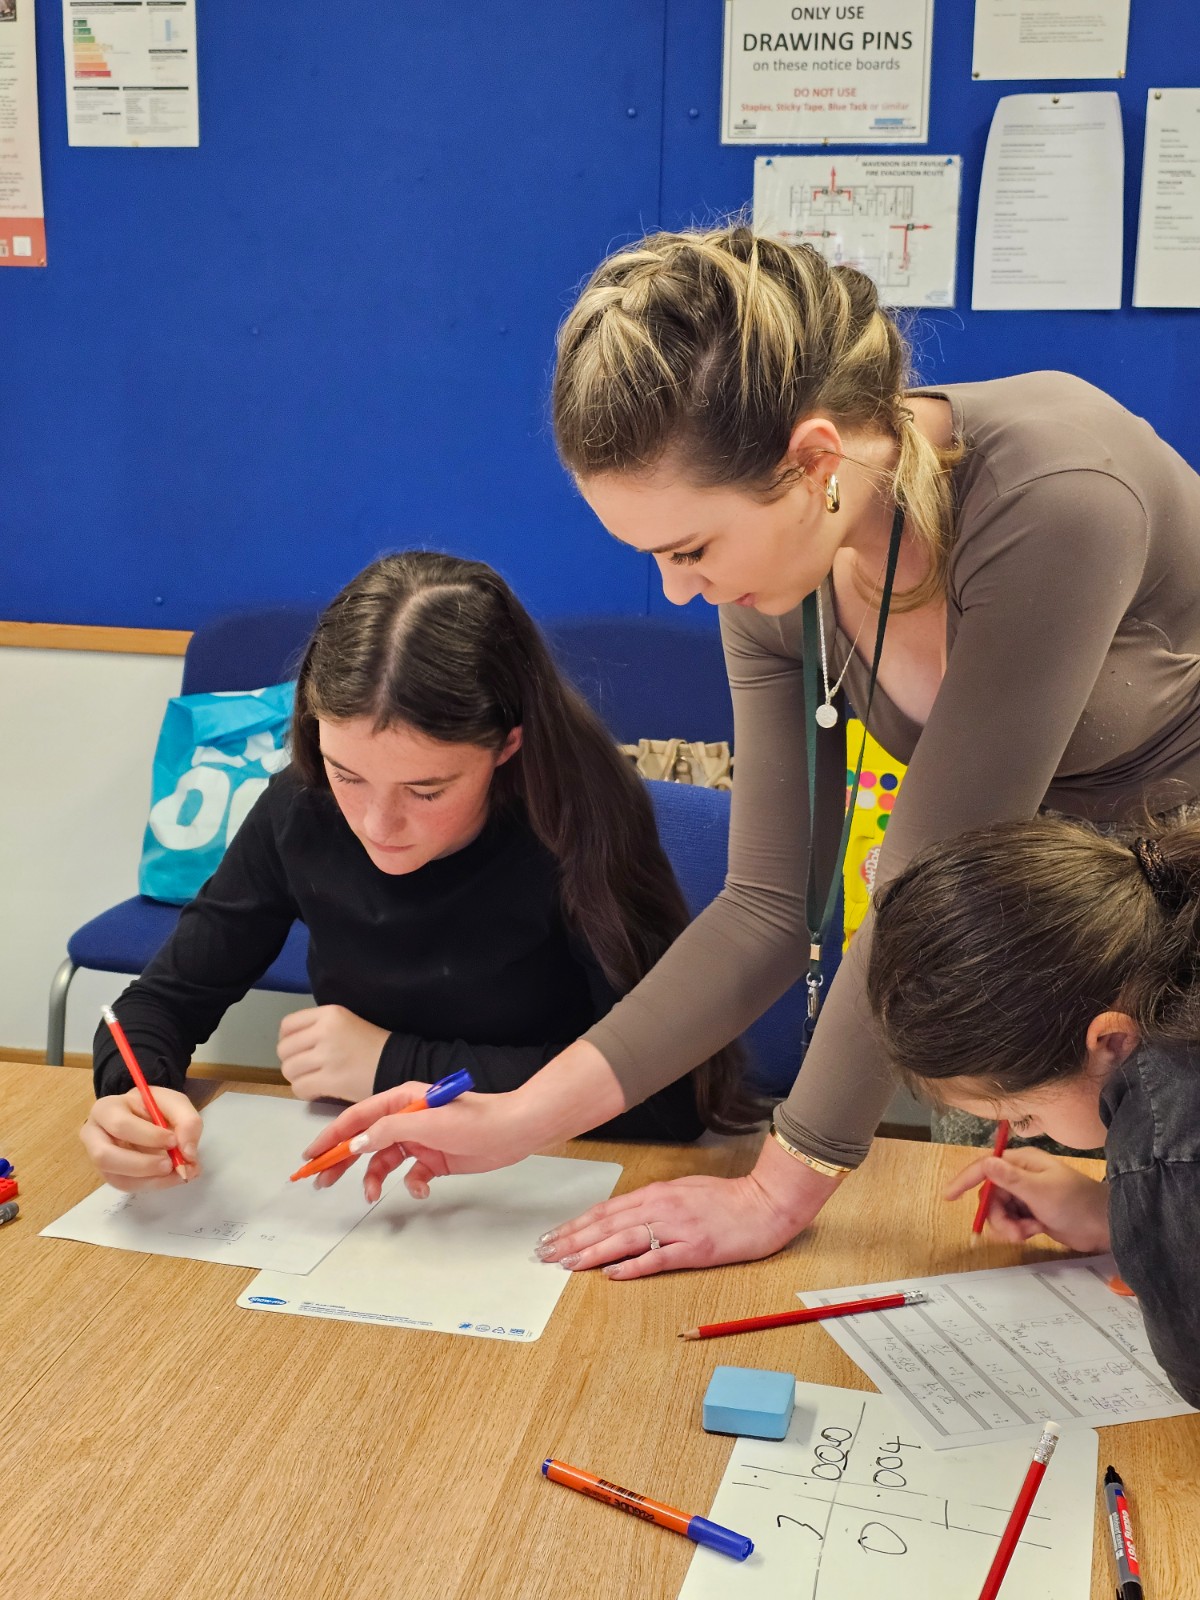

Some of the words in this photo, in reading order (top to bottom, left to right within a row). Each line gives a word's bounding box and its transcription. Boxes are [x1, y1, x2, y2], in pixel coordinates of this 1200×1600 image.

[791, 6, 831, 20] ONLY
[836, 6, 865, 20] USE
[743, 32, 853, 52] DRAWING
[862, 31, 913, 50] PINS
[753, 61, 770, 72] on
[773, 59, 808, 72] these
[812, 59, 852, 71] notice
[856, 58, 901, 71] boards
[793, 88, 810, 97] DO
[812, 88, 834, 97] NOT
[837, 88, 857, 97] USE
[741, 103, 773, 113] Staples,
[775, 103, 801, 113] Sticky
[803, 103, 824, 113] Tape,
[828, 103, 846, 111] Blue
[849, 103, 868, 111] Tack
[870, 103, 879, 111] or
[881, 102, 910, 111] similar
